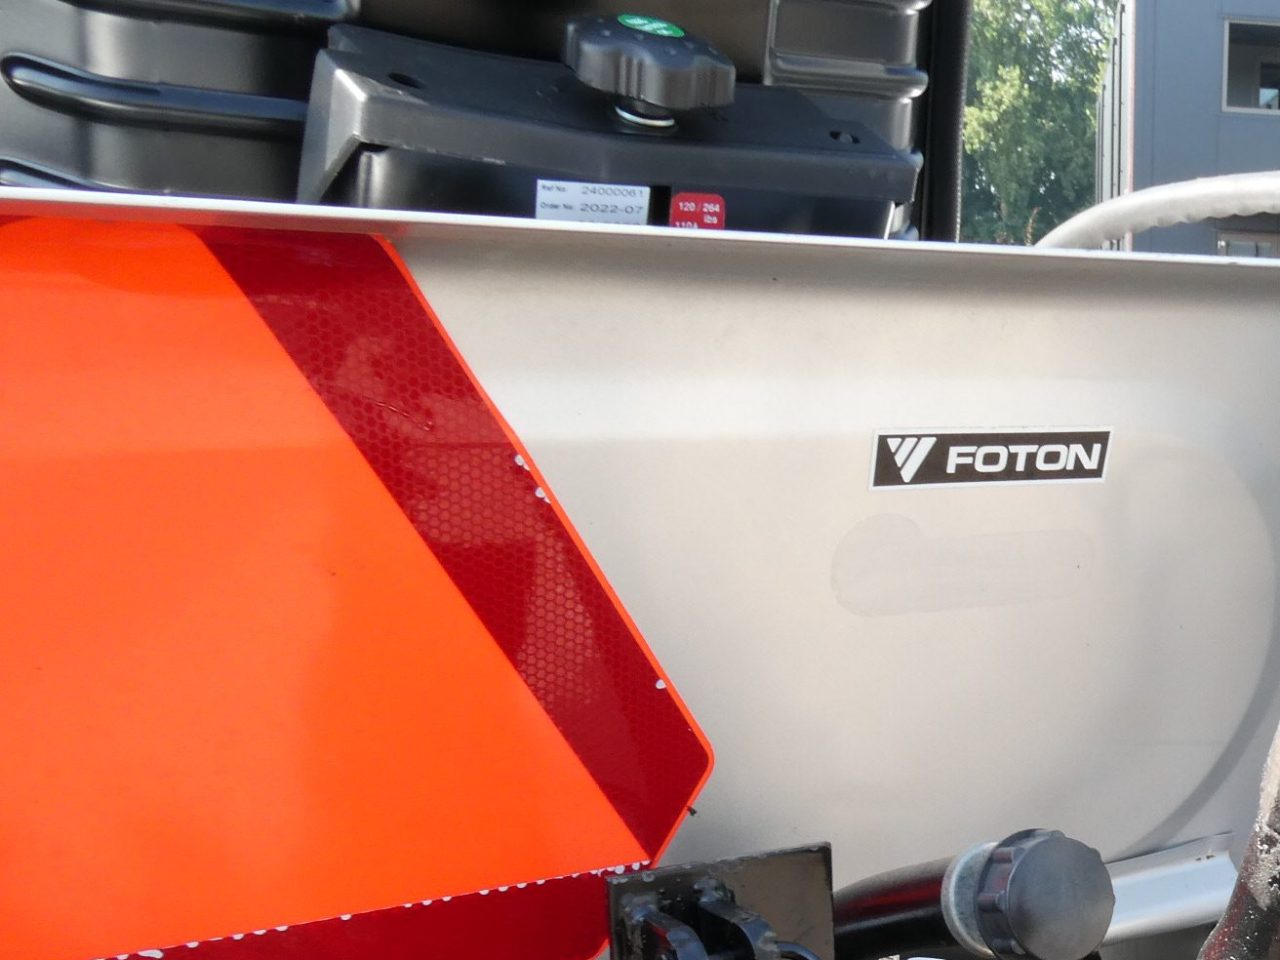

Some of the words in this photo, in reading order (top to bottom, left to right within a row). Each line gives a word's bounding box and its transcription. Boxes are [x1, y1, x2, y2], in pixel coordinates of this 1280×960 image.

[679, 201, 696, 211] 120
[702, 203, 720, 213] 264
[945, 443, 1102, 474] FOTON
